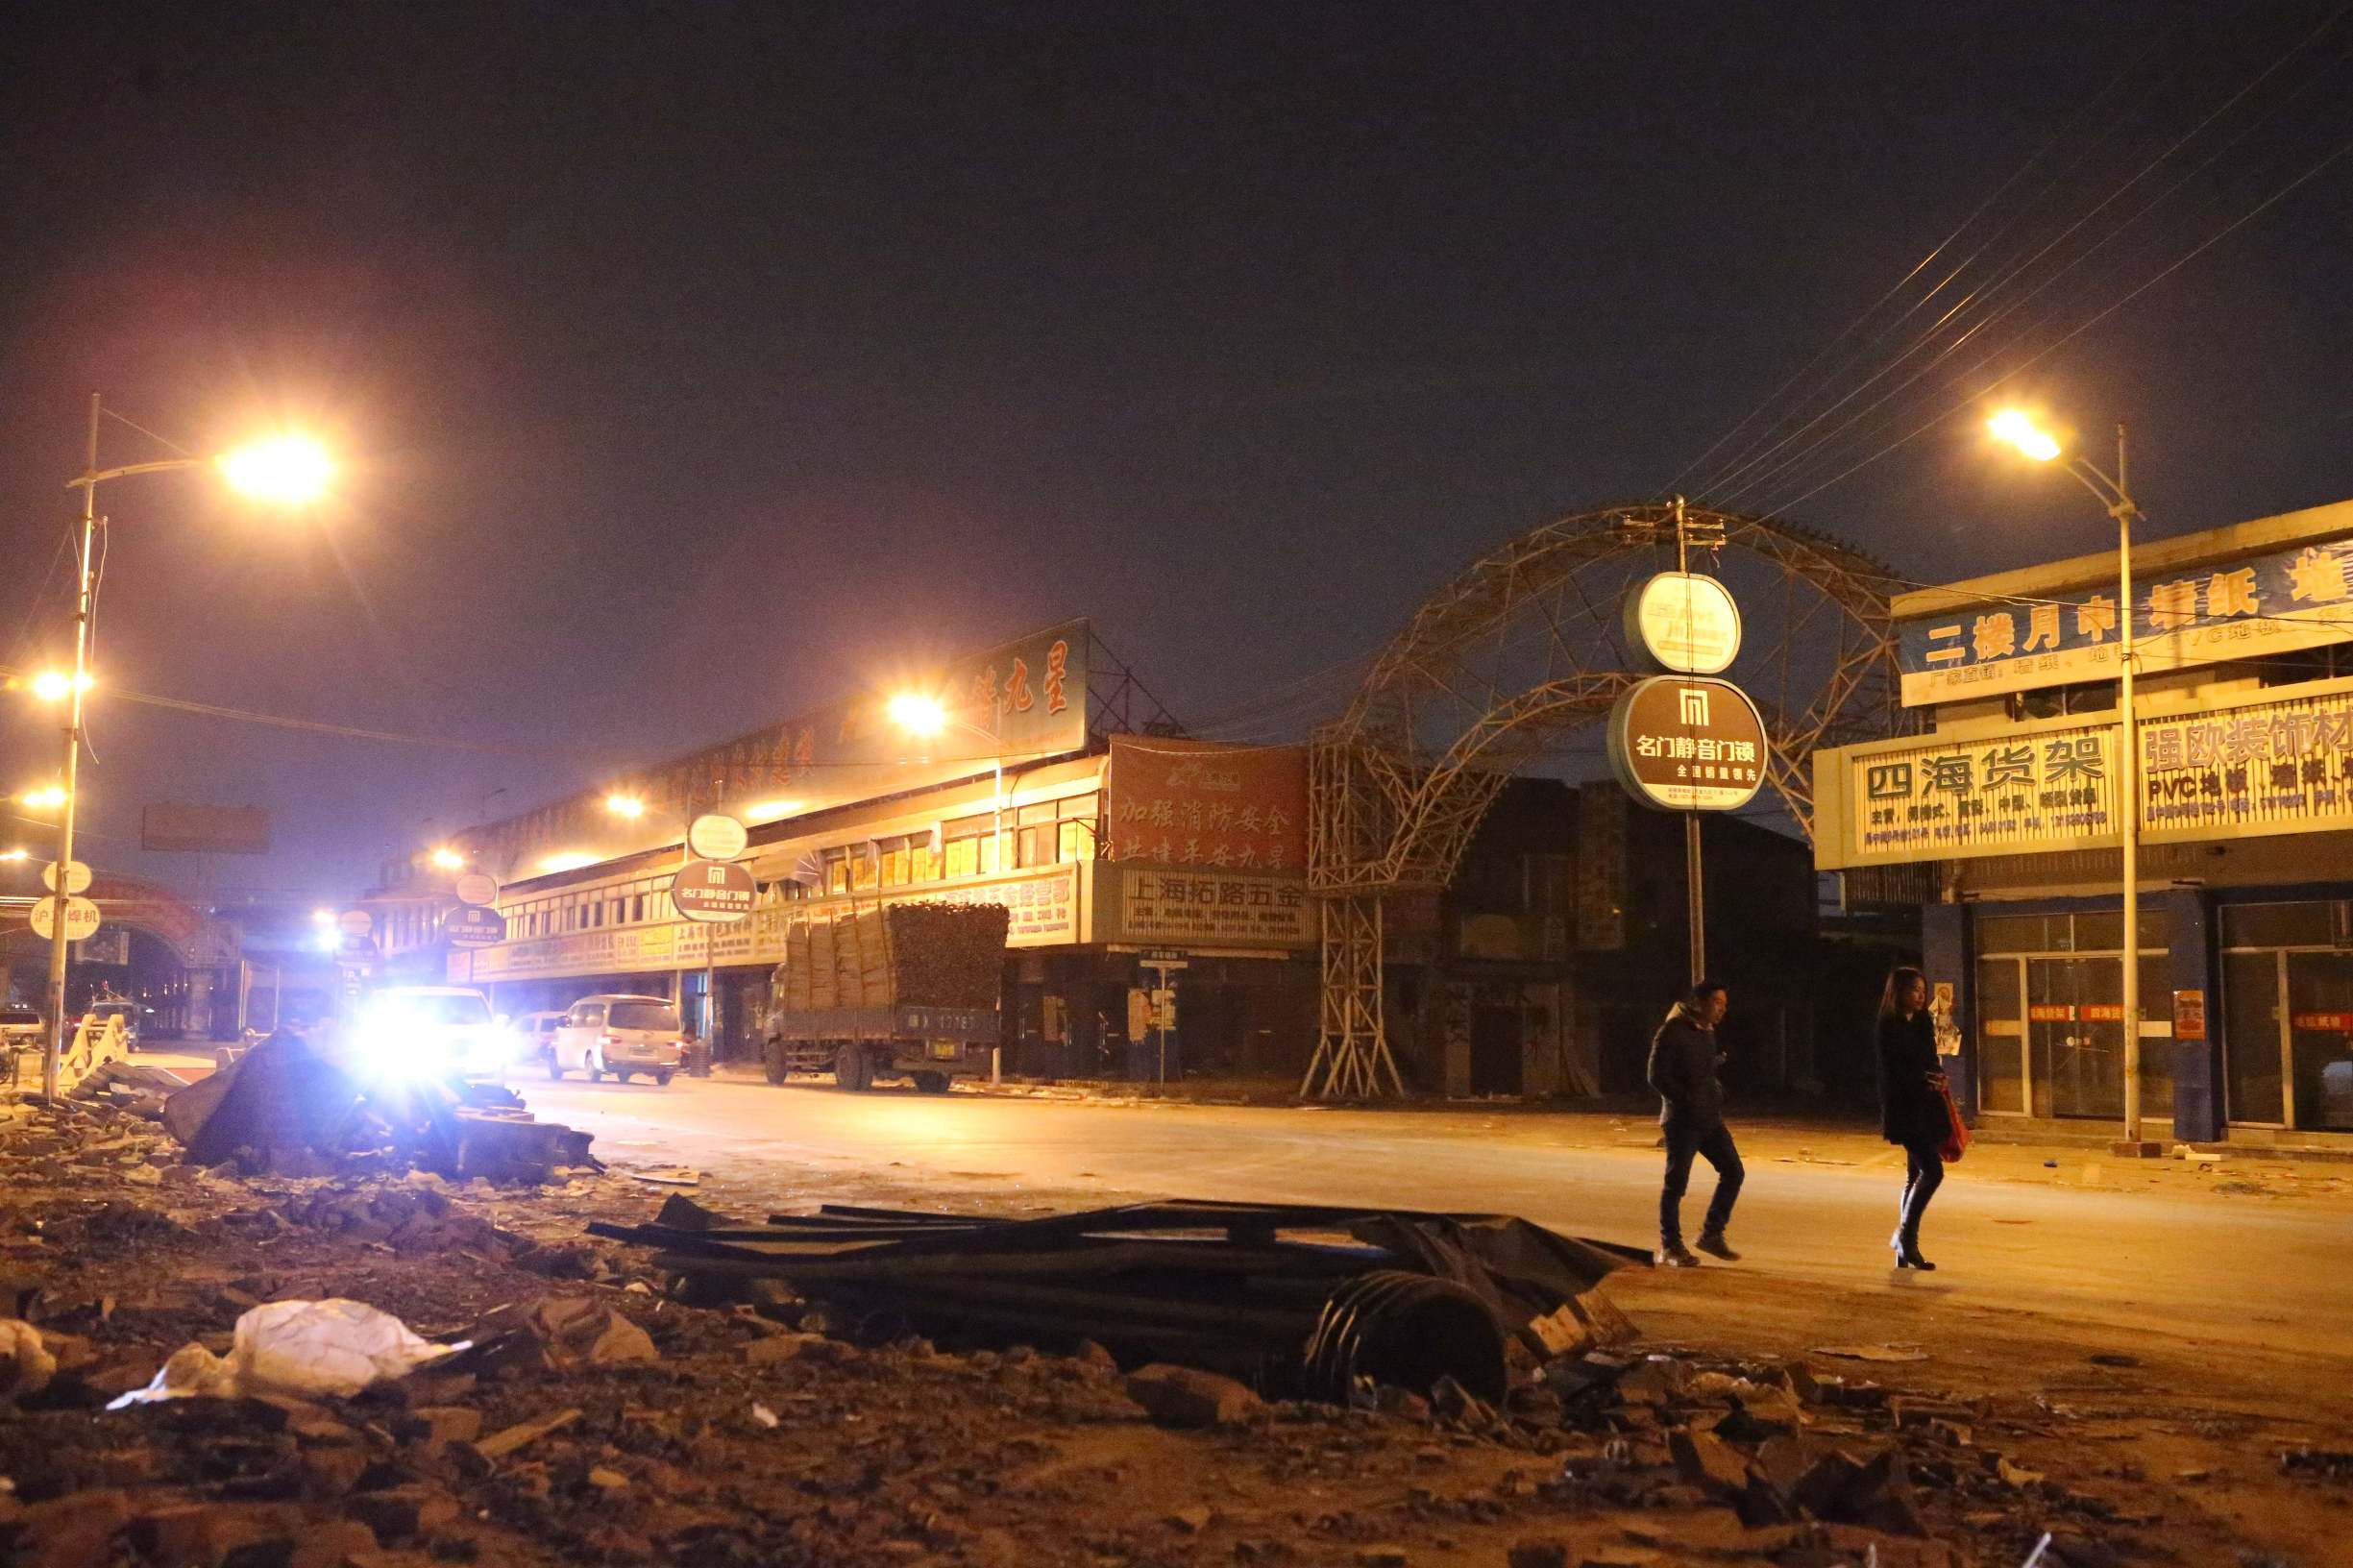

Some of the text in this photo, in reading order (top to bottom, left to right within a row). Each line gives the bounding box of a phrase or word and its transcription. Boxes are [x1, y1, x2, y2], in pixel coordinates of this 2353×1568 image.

[1635, 734, 1756, 764] 名门静音门锁
[1868, 736, 2106, 800] 四海货架
[1119, 796, 1290, 835] 加强消防安全
[1128, 875, 1302, 908] 上海拓路五金
[35, 909, 98, 923] 沪焊机
